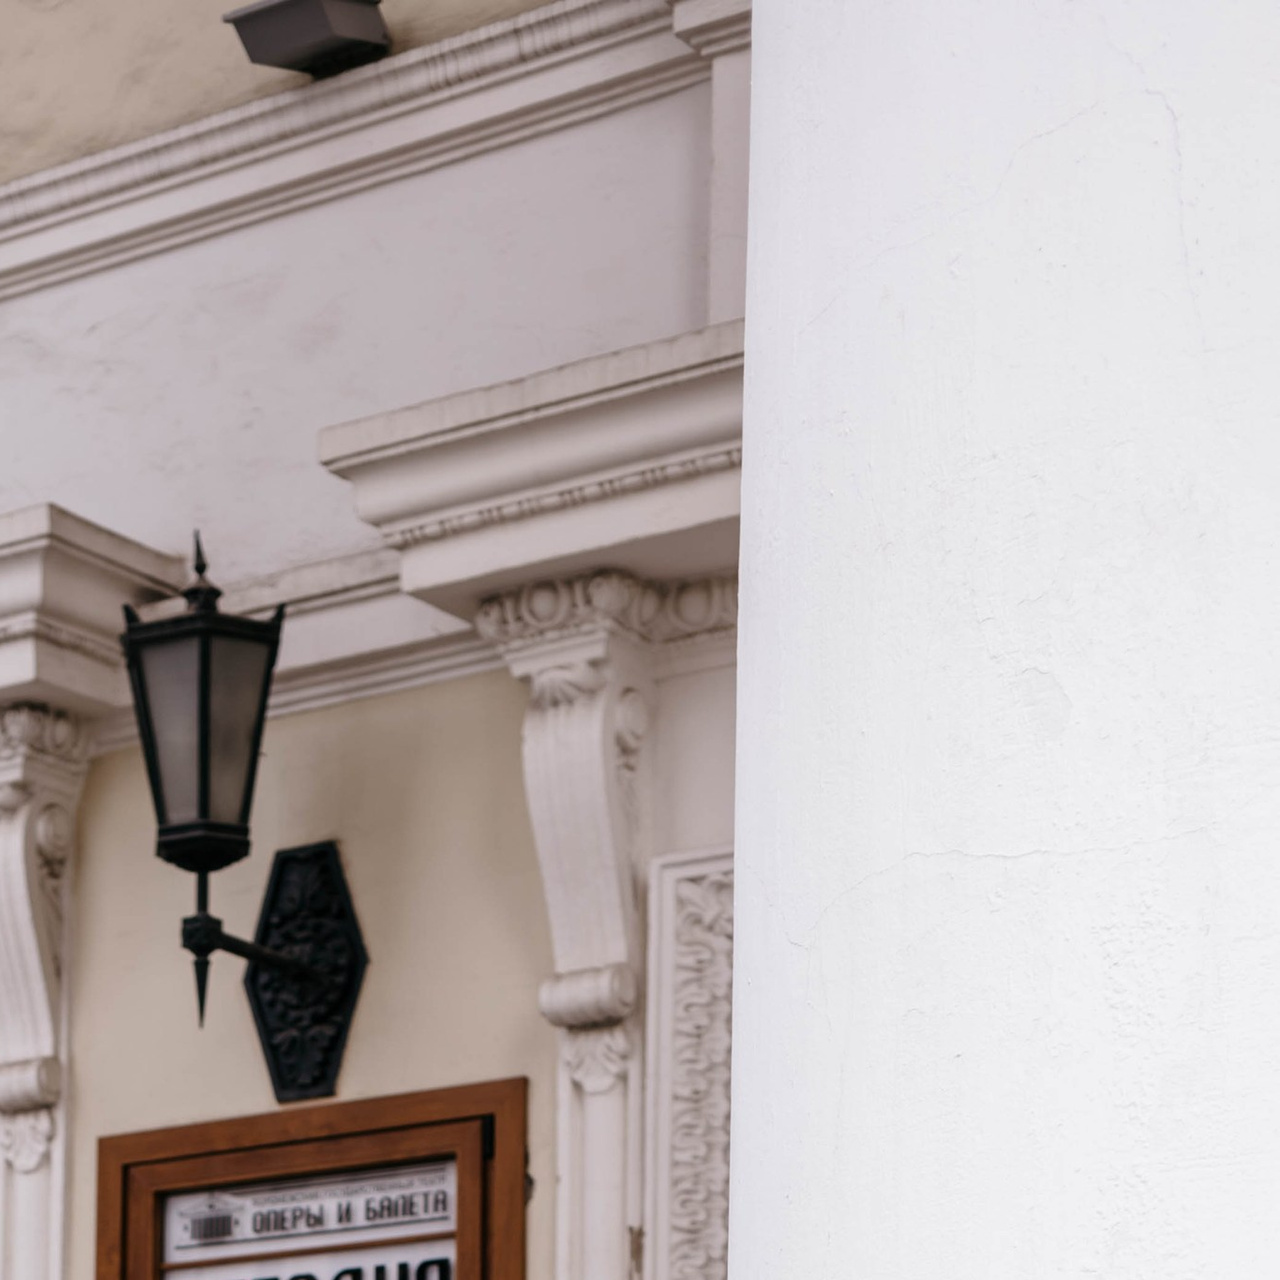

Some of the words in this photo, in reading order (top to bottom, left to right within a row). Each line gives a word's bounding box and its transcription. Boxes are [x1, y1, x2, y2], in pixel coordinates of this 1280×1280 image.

[252, 1205, 325, 1235] ОПЕРЫ
[337, 1201, 353, 1225] И
[365, 1190, 449, 1222] БАЛЕТА
